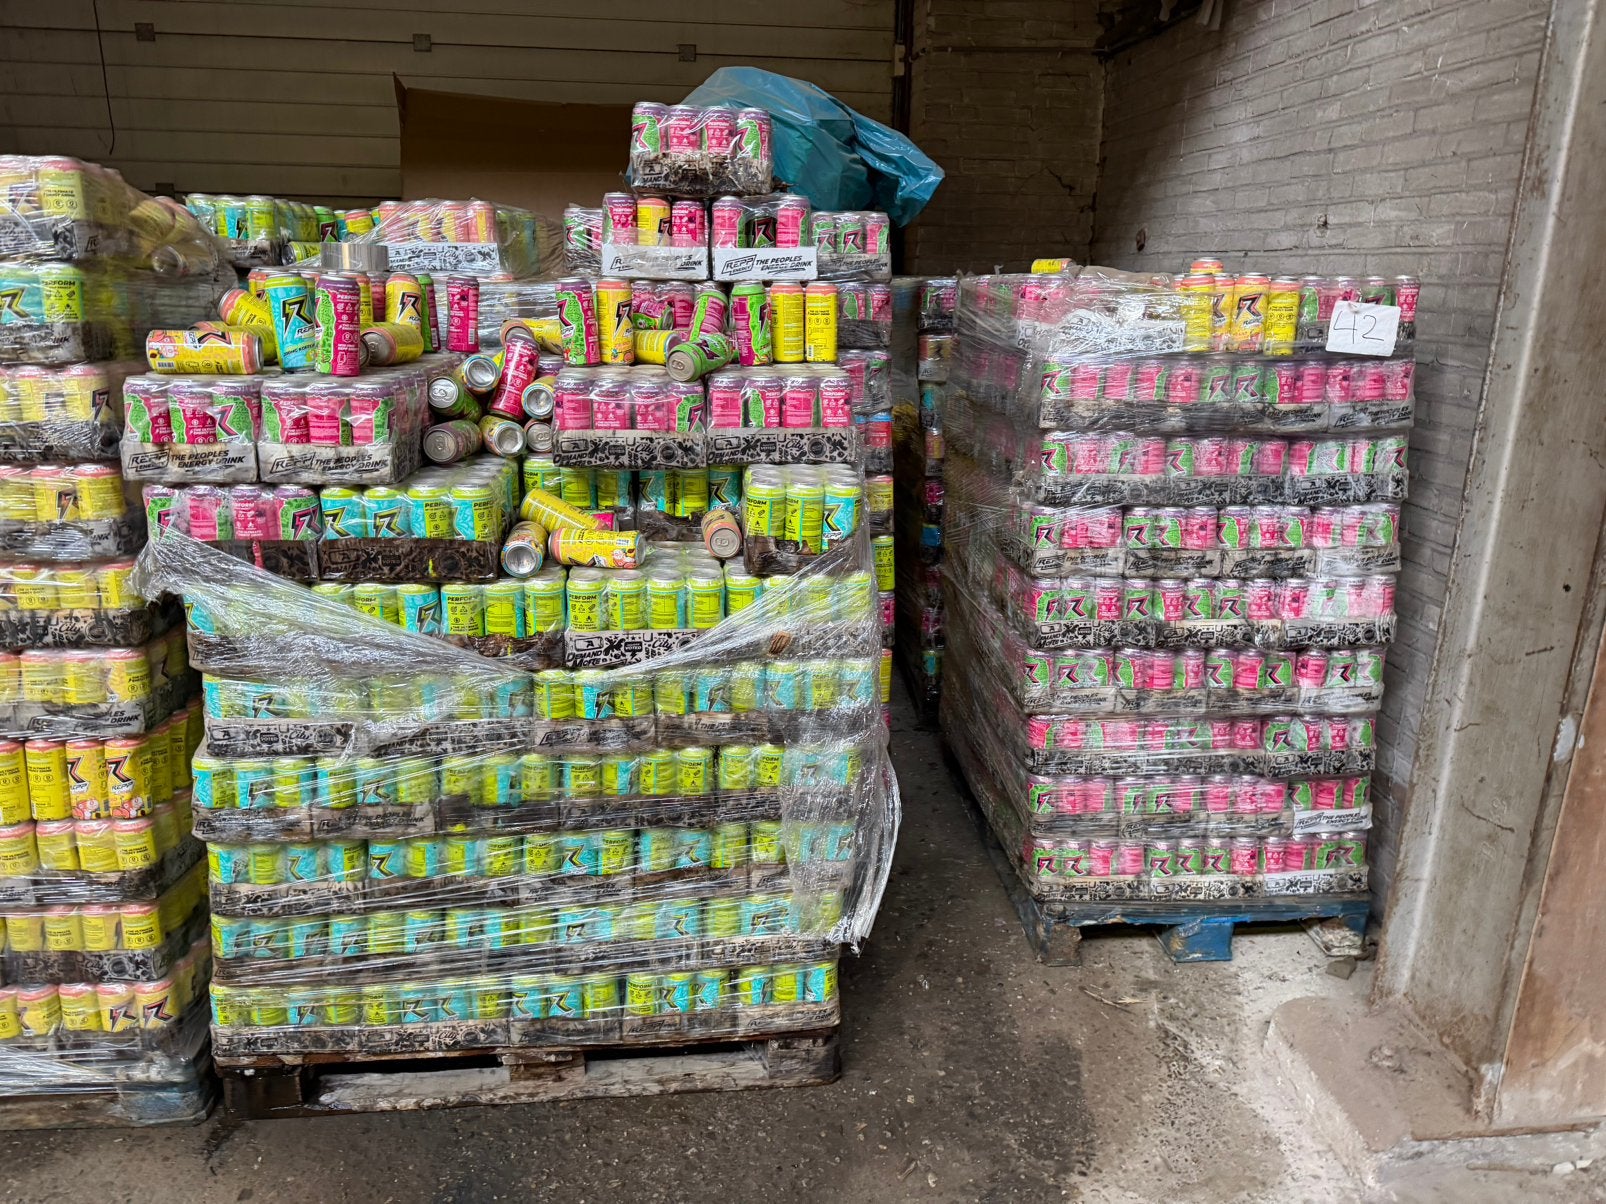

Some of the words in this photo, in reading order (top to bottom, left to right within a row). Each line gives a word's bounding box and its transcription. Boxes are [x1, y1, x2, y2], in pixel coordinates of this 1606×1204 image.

[770, 255, 803, 264] PEOPLES
[1333, 310, 1385, 345] 42
[131, 452, 169, 464] REPP
[188, 450, 230, 460] PEOPLES
[333, 454, 373, 464] PEOPLES
[177, 459, 214, 468] ENERGY
[652, 639, 674, 651] City
[566, 650, 603, 662] DEMAND
[572, 657, 601, 667] MORE
[110, 714, 141, 723] DRINK
